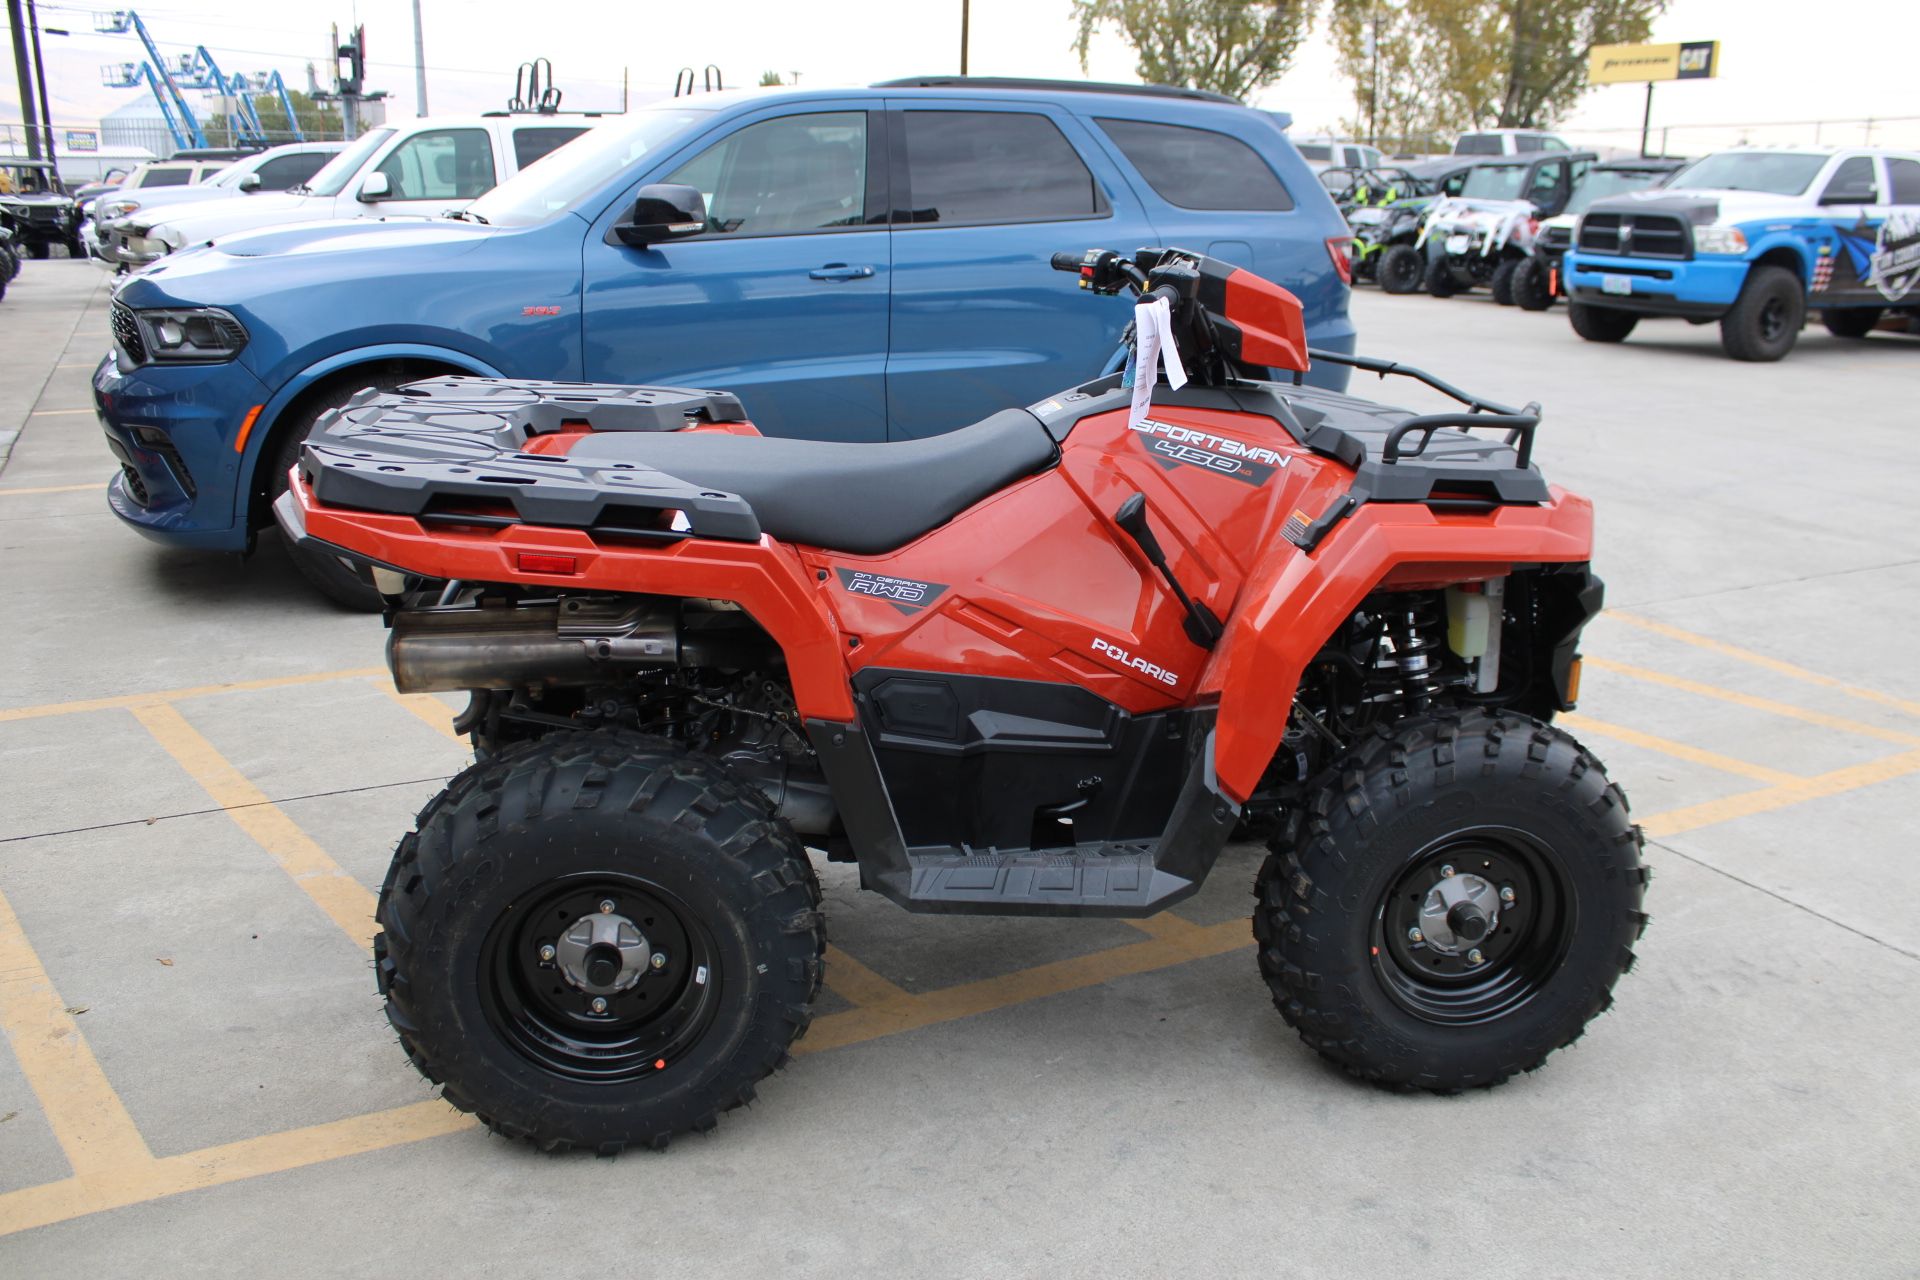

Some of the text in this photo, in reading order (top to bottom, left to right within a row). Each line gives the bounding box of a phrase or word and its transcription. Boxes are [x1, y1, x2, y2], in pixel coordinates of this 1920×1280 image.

[1679, 48, 1711, 71] CAT
[1135, 419, 1292, 468] SPORTSMAN
[1154, 440, 1242, 474] 450
[847, 578, 925, 602] AWD
[876, 576, 928, 589] DEMAND
[1091, 637, 1179, 686] POLARIS
